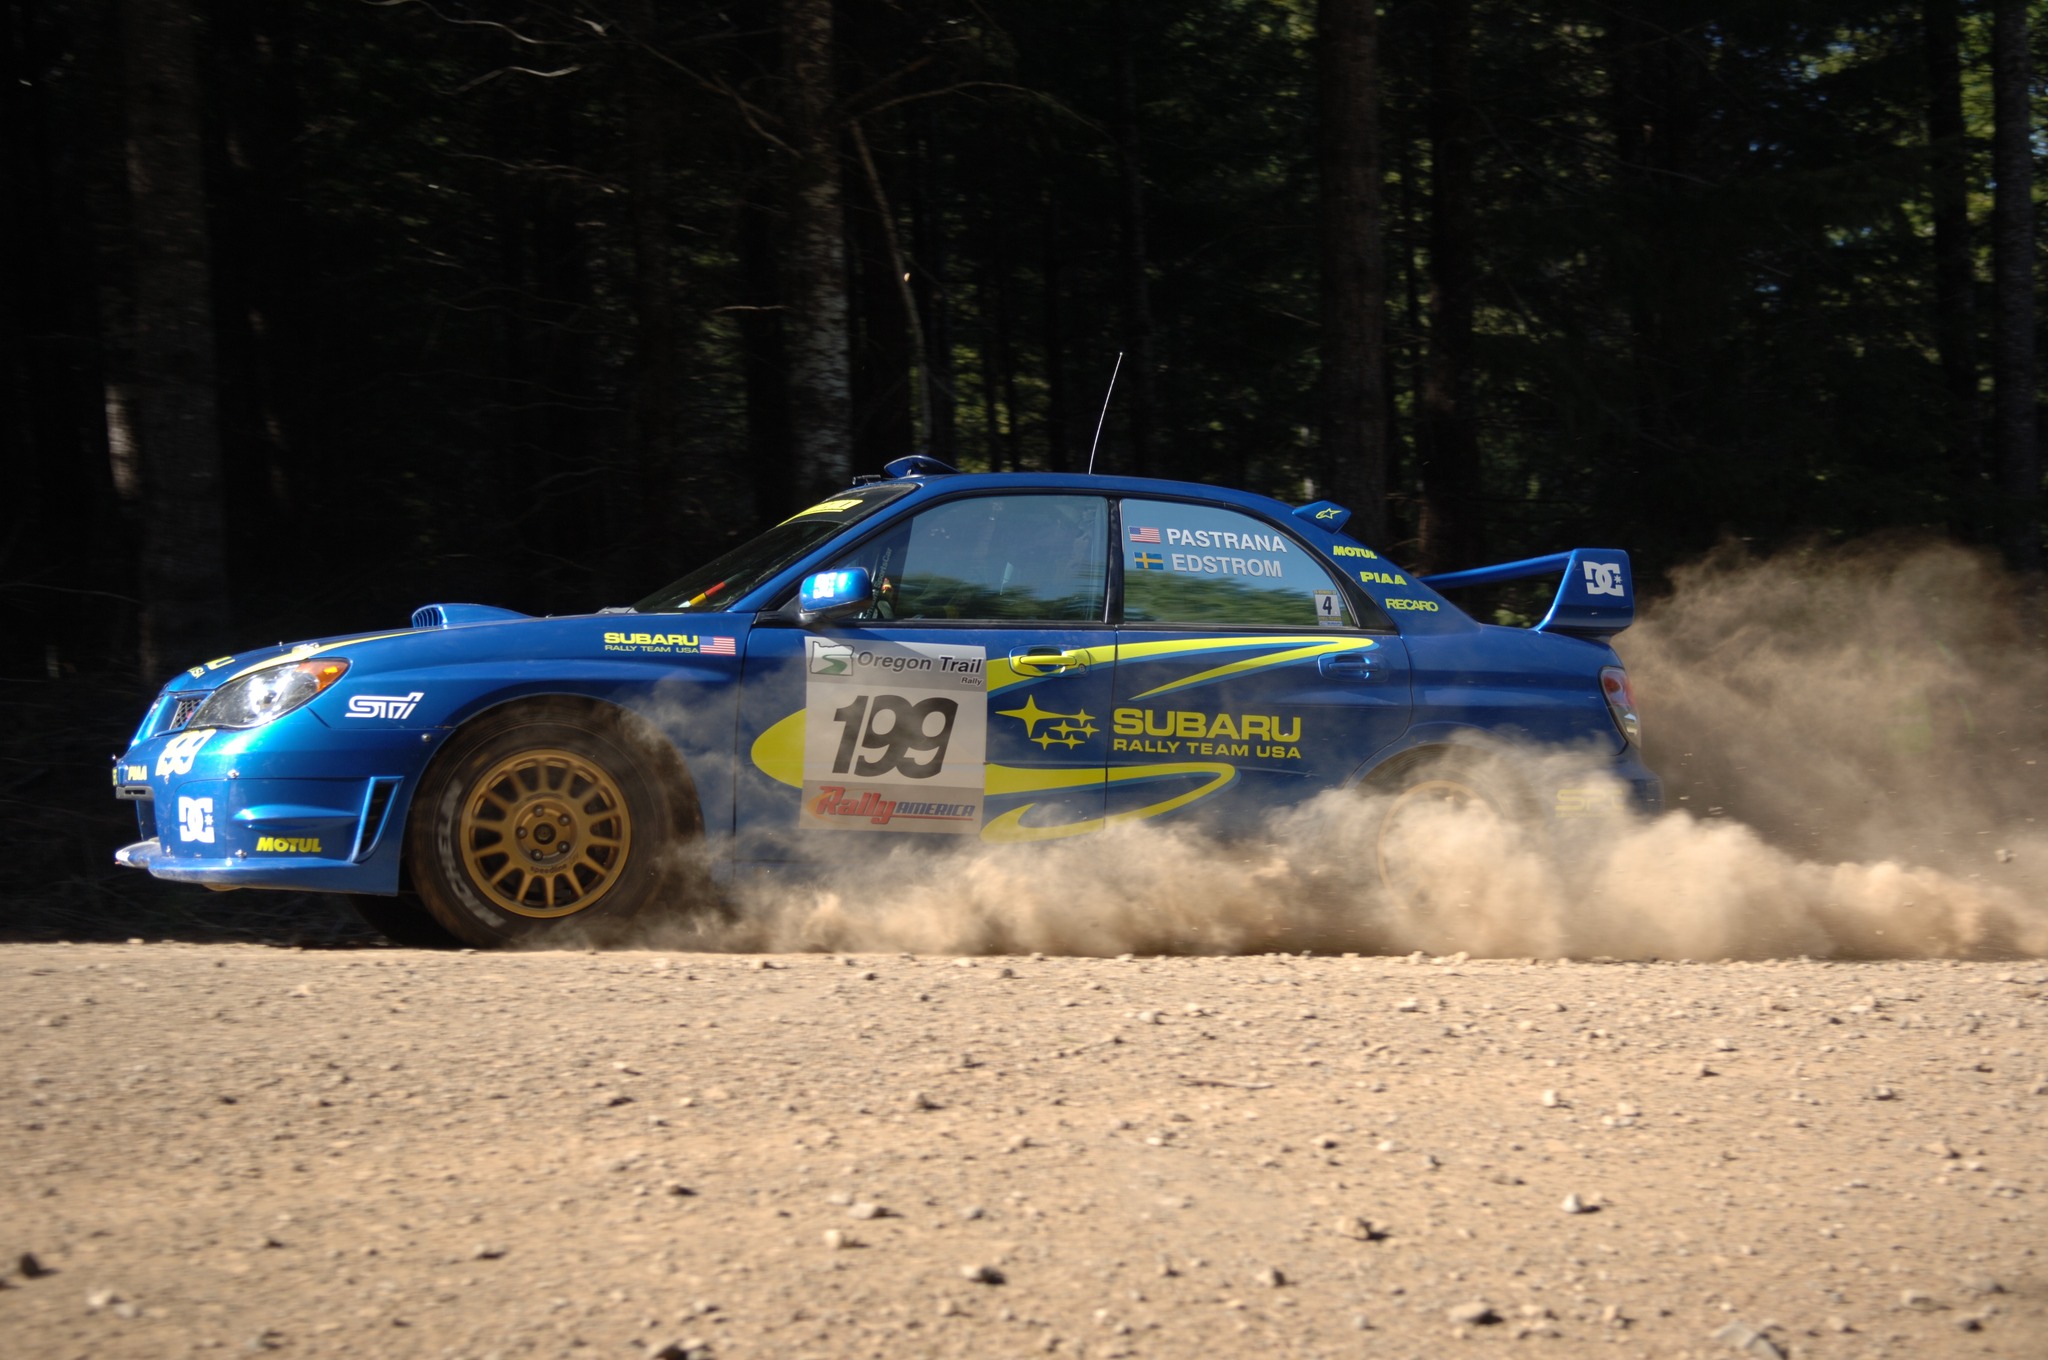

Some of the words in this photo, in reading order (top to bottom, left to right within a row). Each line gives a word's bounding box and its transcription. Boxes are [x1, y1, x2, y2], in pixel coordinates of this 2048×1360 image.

[1166, 528, 1288, 553] PASTRANA
[1333, 545, 1378, 559] MOTUL
[1171, 553, 1283, 578] EDSTROM
[1360, 571, 1407, 585] PIAA
[1582, 561, 1625, 597] DC
[1322, 595, 1333, 616] 4
[1385, 598, 1440, 612] RECARO
[604, 632, 699, 646] SUBARU
[604, 644, 637, 652] RALLY
[640, 645, 672, 653] TEAM
[676, 646, 700, 654] USA
[857, 651, 932, 673] Oregon
[939, 656, 983, 674] Trail
[961, 676, 983, 687] Rally
[832, 694, 959, 779] 199
[1113, 708, 1302, 743] SUBARU
[1113, 738, 1181, 754] RALLY
[1186, 742, 1249, 757] TEAM
[1256, 746, 1302, 760] USA
[815, 786, 897, 825] Rally
[895, 801, 976, 818] AMERICA
[178, 796, 215, 843] DC
[256, 837, 323, 853] MOTUL
